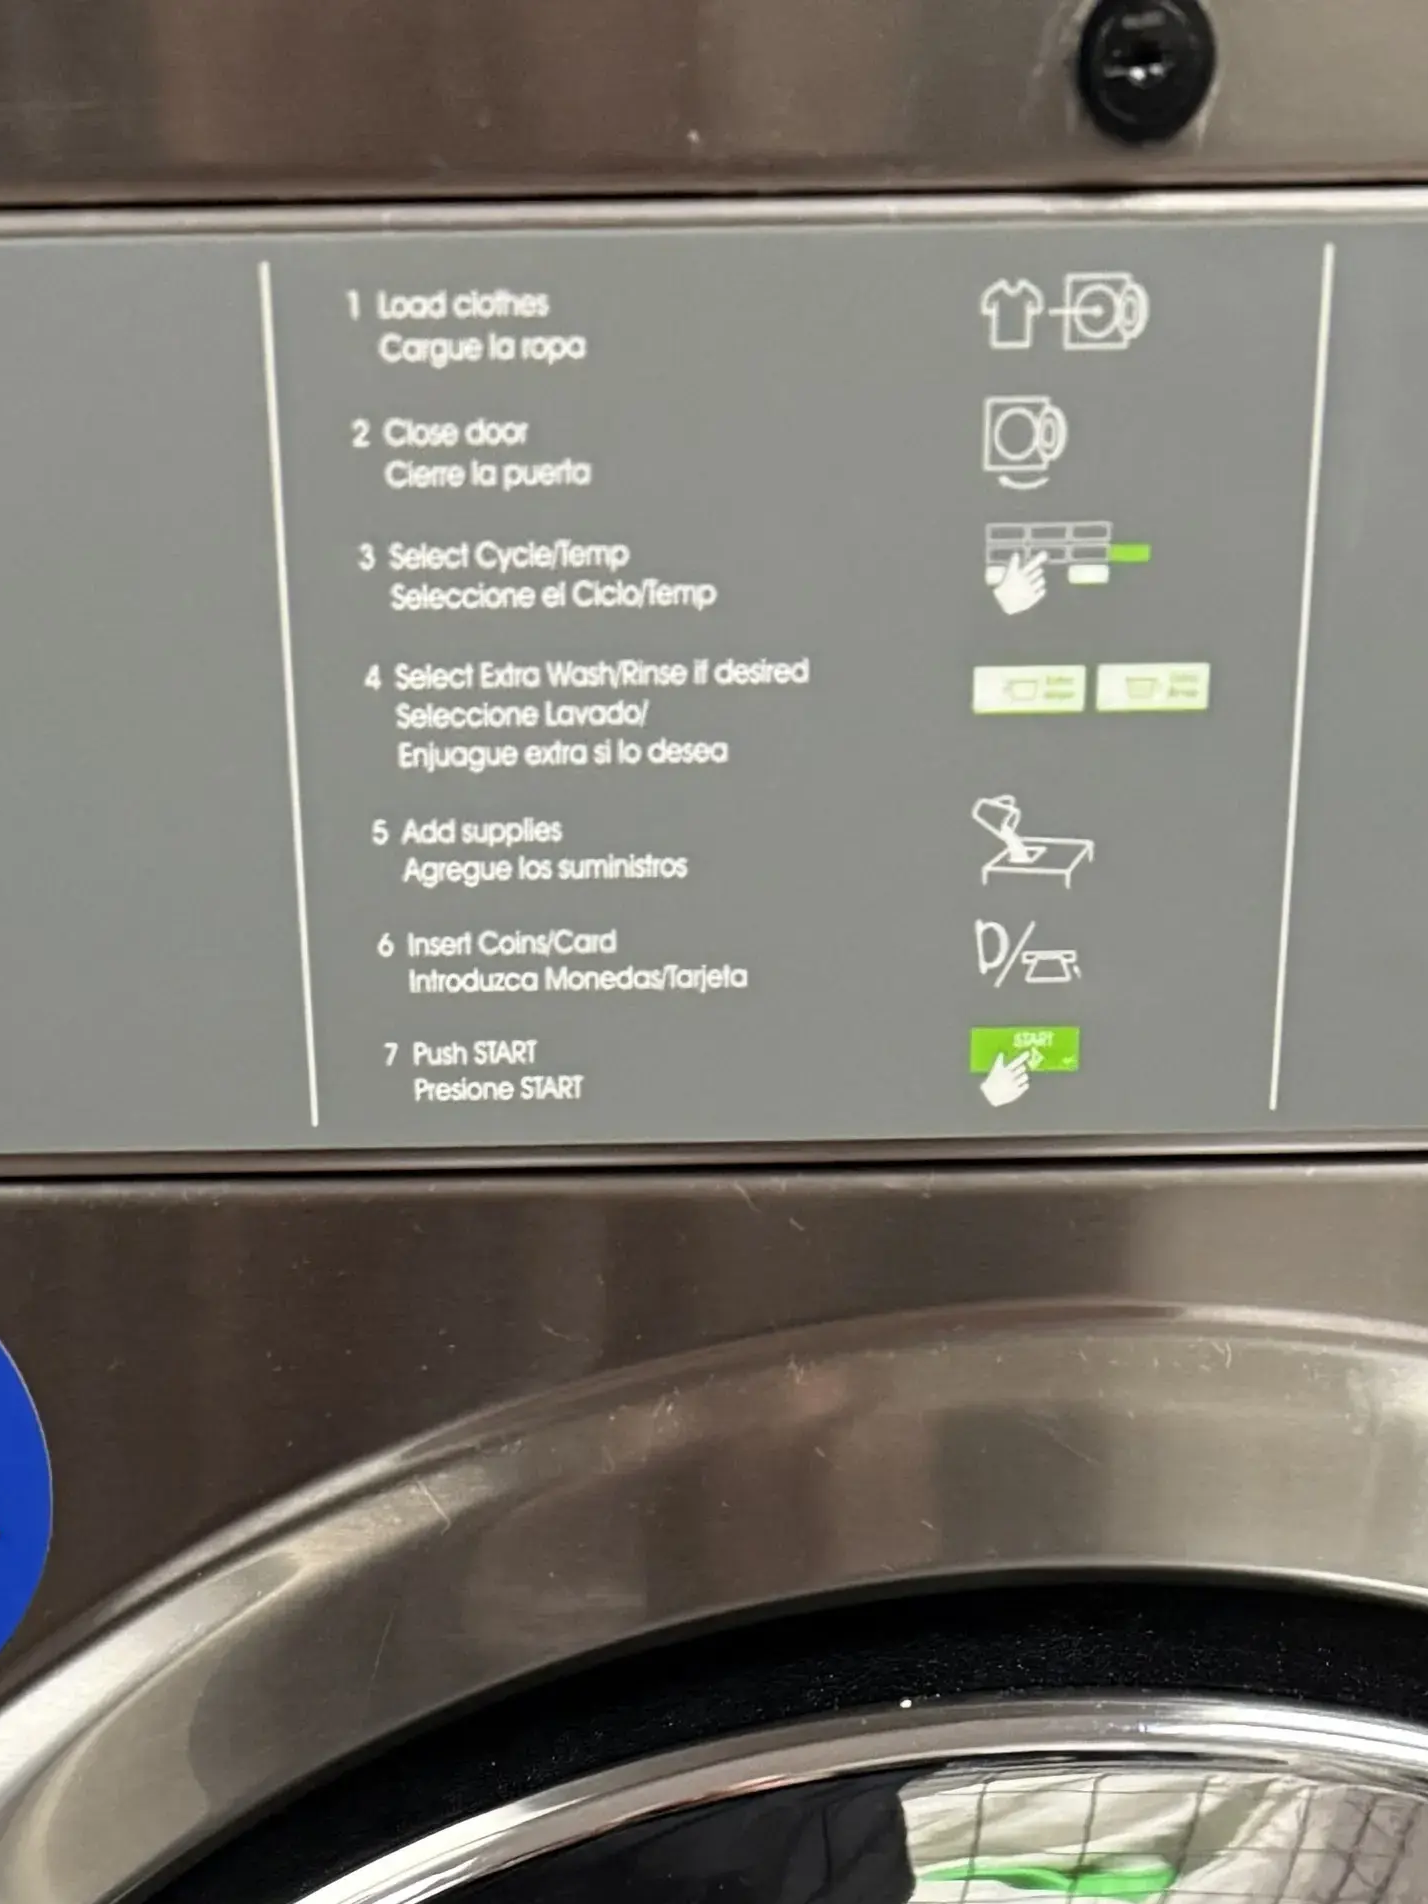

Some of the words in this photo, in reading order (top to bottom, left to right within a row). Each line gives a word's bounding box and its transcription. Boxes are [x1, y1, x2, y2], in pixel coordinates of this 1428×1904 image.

[347, 289, 360, 320] 1
[377, 291, 447, 319] Load
[452, 289, 550, 318] clothes
[378, 332, 483, 369] Cargue
[488, 333, 515, 360] la
[521, 336, 586, 365] ropa
[352, 418, 370, 448] 2
[383, 418, 459, 447] Close
[465, 418, 528, 446] door
[384, 460, 465, 489] Cierre
[471, 460, 497, 486] la
[503, 458, 591, 491] puerta
[358, 543, 376, 571] 3
[389, 542, 469, 570] Select
[474, 539, 630, 573] Cycle/Temp
[390, 583, 536, 611] Seleccione
[541, 581, 566, 608] el
[572, 578, 717, 611] Ciclo/Temp
[364, 664, 381, 690] 4
[395, 663, 474, 690] Select
[480, 662, 541, 689] Extra
[546, 659, 688, 689] Wash/Rinse
[693, 659, 709, 684] if
[714, 658, 809, 685] desired
[396, 702, 539, 729] Seleccione
[398, 742, 518, 773] Enjuague
[524, 740, 588, 766] extra
[593, 739, 611, 765] si
[617, 738, 642, 764] lo
[647, 738, 728, 764] desea
[372, 819, 389, 845] 5
[401, 819, 456, 844] Add
[461, 817, 563, 847] supplies
[402, 857, 513, 888] Agregue
[518, 856, 553, 880] los
[558, 854, 688, 880] suministros
[377, 933, 394, 957] 6
[407, 932, 472, 957] Insert
[477, 929, 617, 956] Coins/Card
[409, 968, 538, 993] Introduzca
[545, 964, 747, 993] Monedas/Tarjeta
[384, 1042, 398, 1066] 7
[413, 1042, 468, 1066] Push
[474, 1040, 537, 1065] START
[414, 1077, 514, 1101] Presione
[520, 1075, 584, 1100] START
